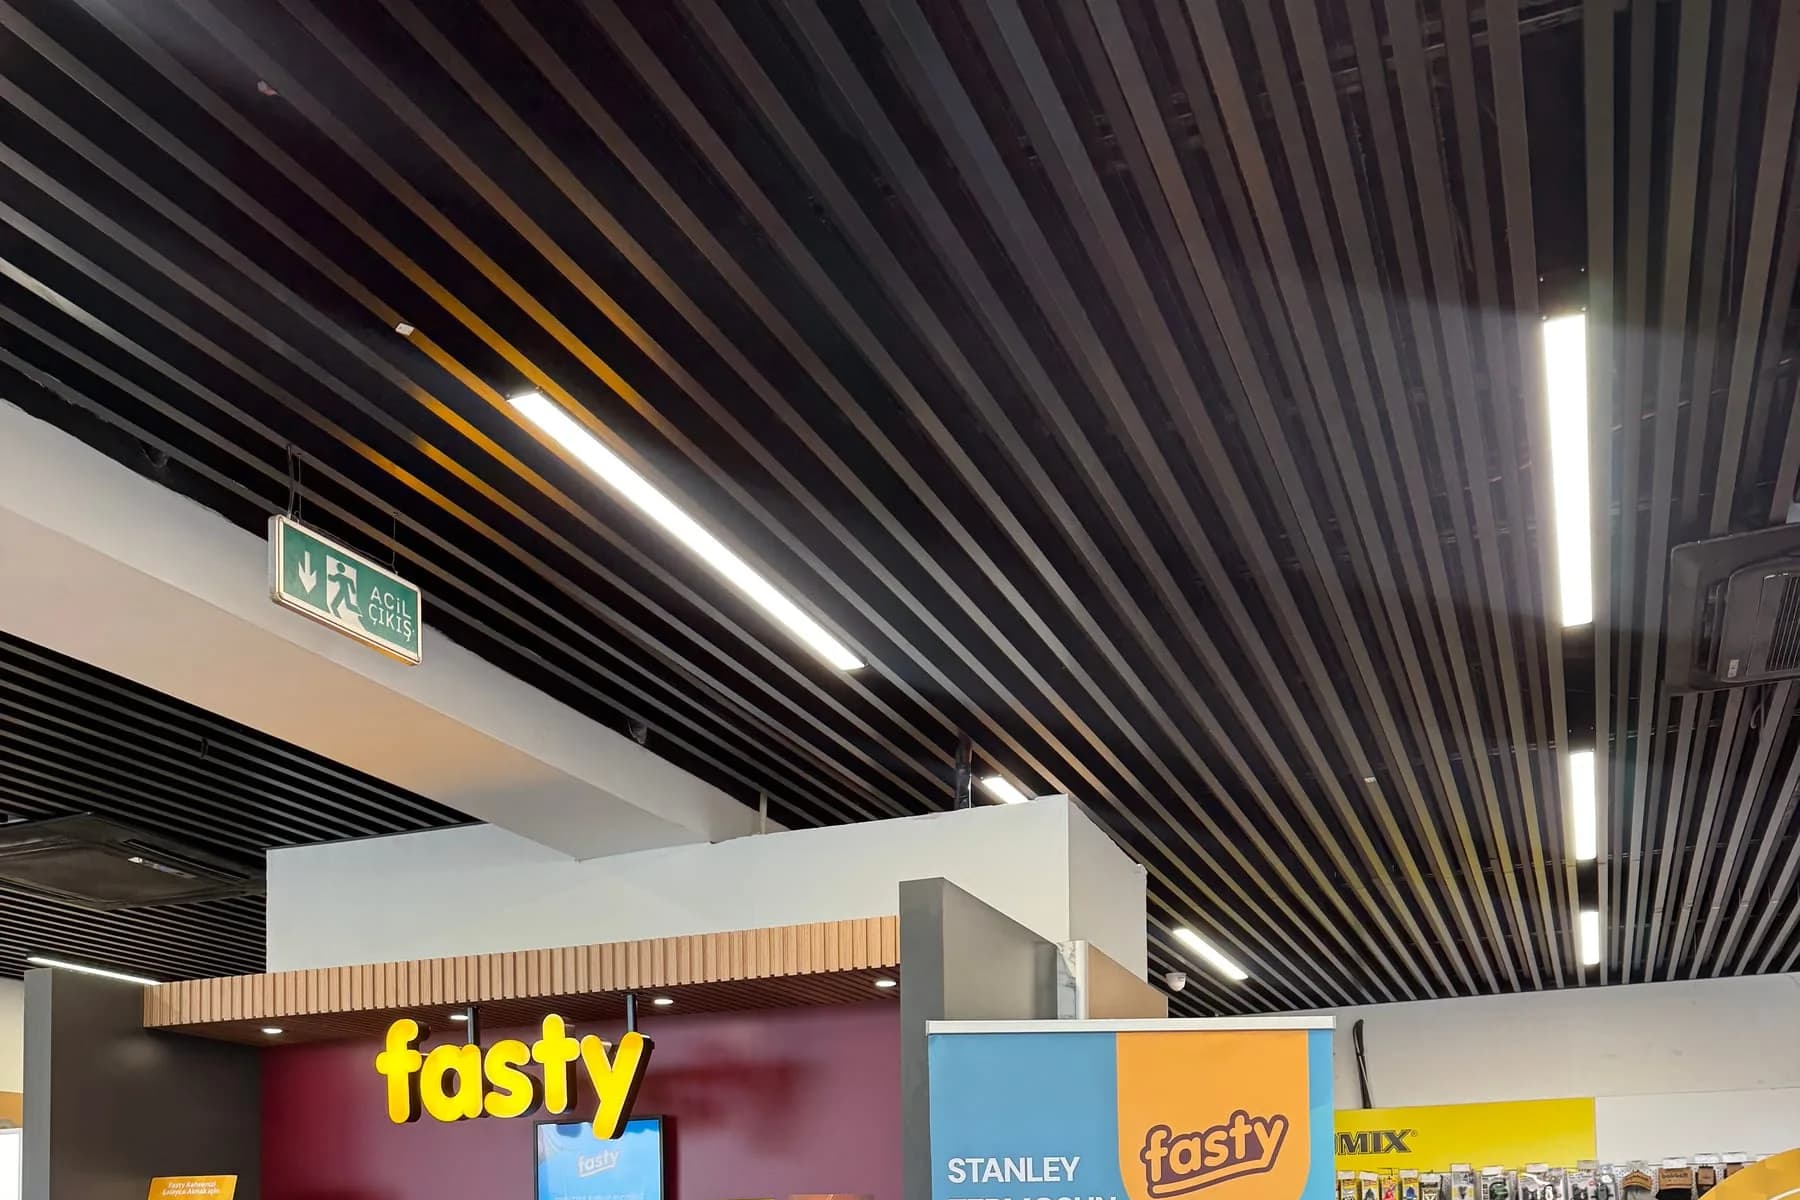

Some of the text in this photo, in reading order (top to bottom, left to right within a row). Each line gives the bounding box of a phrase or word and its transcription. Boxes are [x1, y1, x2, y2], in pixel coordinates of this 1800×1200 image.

[370, 586, 411, 619] ACİL
[368, 603, 412, 642] ÇIKIŞ
[375, 1013, 652, 1140] fasty
[1140, 1110, 1289, 1192] fasty
[1335, 1129, 1412, 1156] MIX
[947, 1156, 1080, 1183] STANLEY
